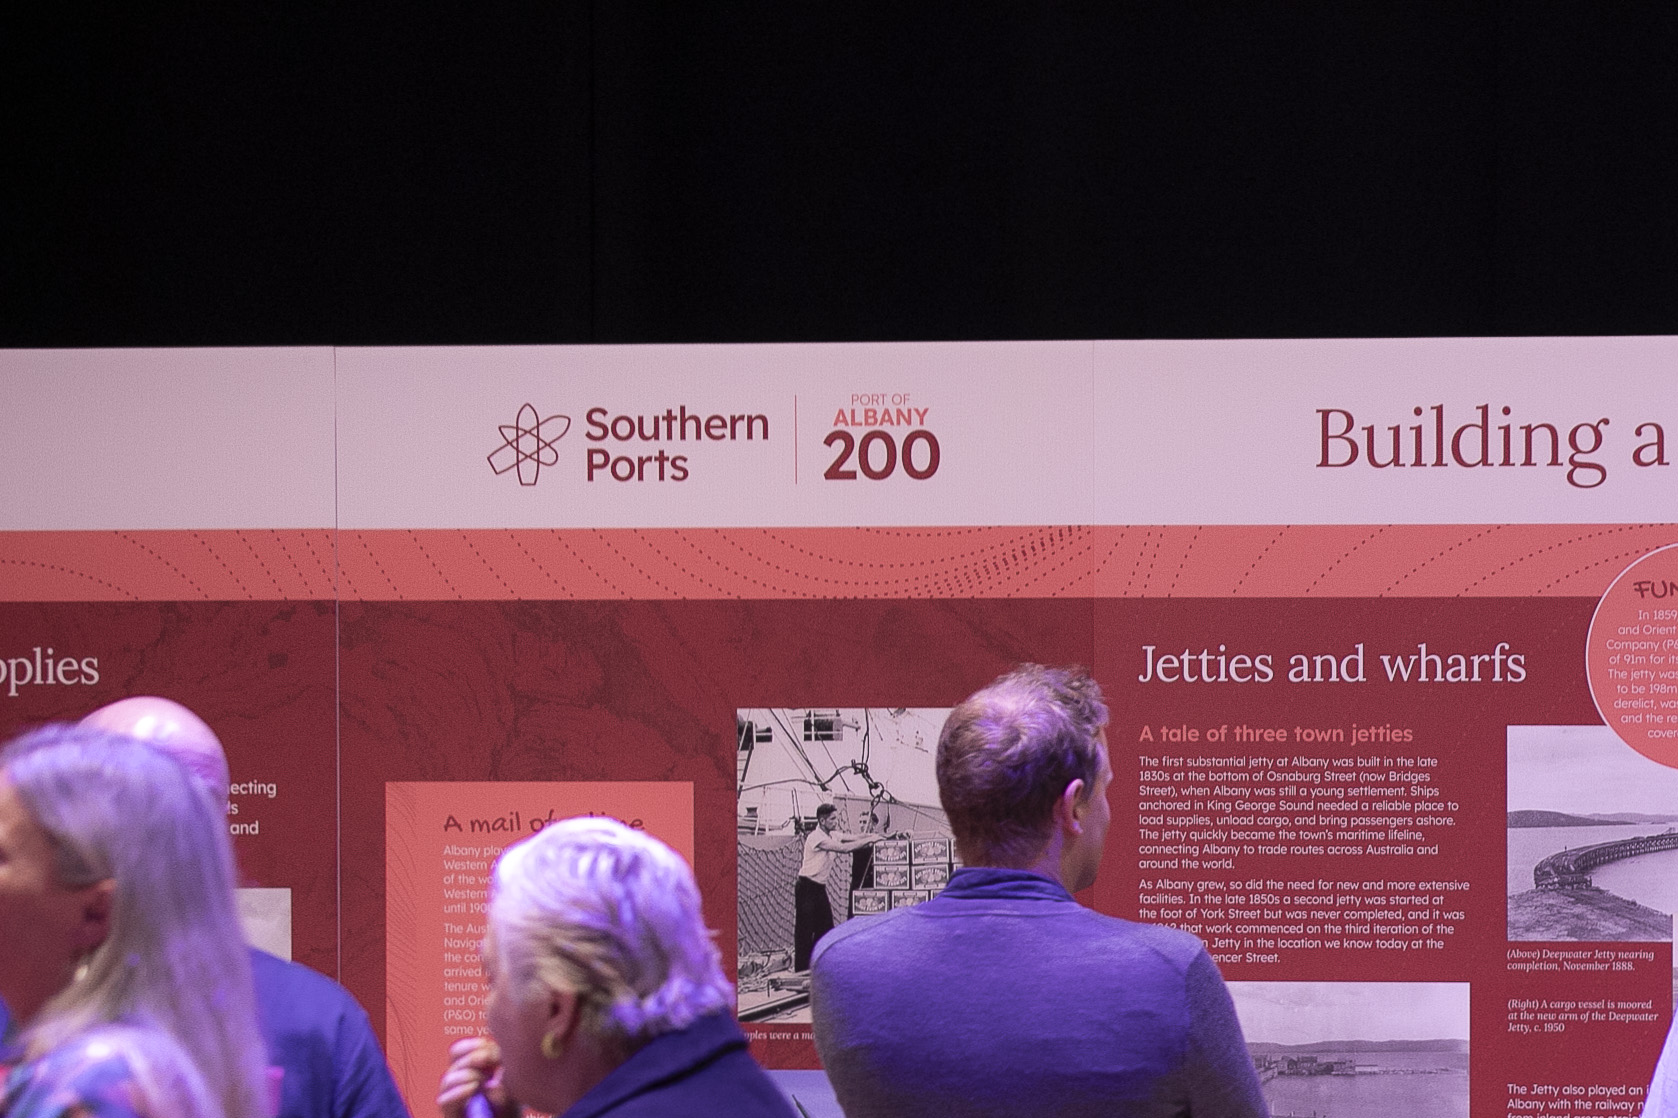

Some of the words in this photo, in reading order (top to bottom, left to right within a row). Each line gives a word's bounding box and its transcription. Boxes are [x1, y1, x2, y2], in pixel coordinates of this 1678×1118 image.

[850, 393, 887, 405] PORT
[891, 393, 911, 405] OF
[585, 405, 769, 442] Southern
[833, 407, 929, 427] ALBANY
[822, 429, 941, 481] 200
[1315, 403, 1610, 489] Building
[1632, 421, 1670, 467] a
[586, 448, 689, 483] Ports
[1638, 609, 1649, 621] In
[1617, 624, 1639, 635] and
[1642, 624, 1676, 635] Orient
[0, 646, 100, 697] plies
[1138, 644, 1274, 683] Jetties
[1287, 643, 1367, 683] and
[1379, 643, 1527, 683] wharfs
[1138, 724, 1154, 742] A
[1160, 724, 1199, 742] tale
[1206, 724, 1228, 742] of
[1233, 724, 1287, 742] three
[1293, 724, 1344, 742] town
[1351, 724, 1413, 747] jetties
[1138, 755, 1159, 767] The
[1161, 755, 1183, 767] first
[1186, 755, 1246, 768] substantial
[1248, 755, 1274, 770] jetty
[1275, 755, 1288, 768] at
[1290, 755, 1329, 770] Albany
[1331, 758, 1354, 768] was
[1356, 755, 1380, 768] built
[1383, 755, 1393, 768] in
[1396, 756, 1414, 768] the
[1416, 756, 1438, 768] late
[228, 778, 277, 799] ecting
[230, 820, 259, 835] and
[443, 813, 463, 833] A
[470, 811, 521, 833] mail
[443, 845, 481, 858] Albany
[443, 860, 488, 871] Western
[1506, 949, 1540, 962] (Above)
[1541, 949, 1592, 962] Deepwater
[1593, 949, 1616, 962] Jetty
[1617, 949, 1654, 963] nearing
[1506, 960, 1560, 972] completion,
[1562, 960, 1610, 971] November
[1611, 960, 1635, 971] 1888.
